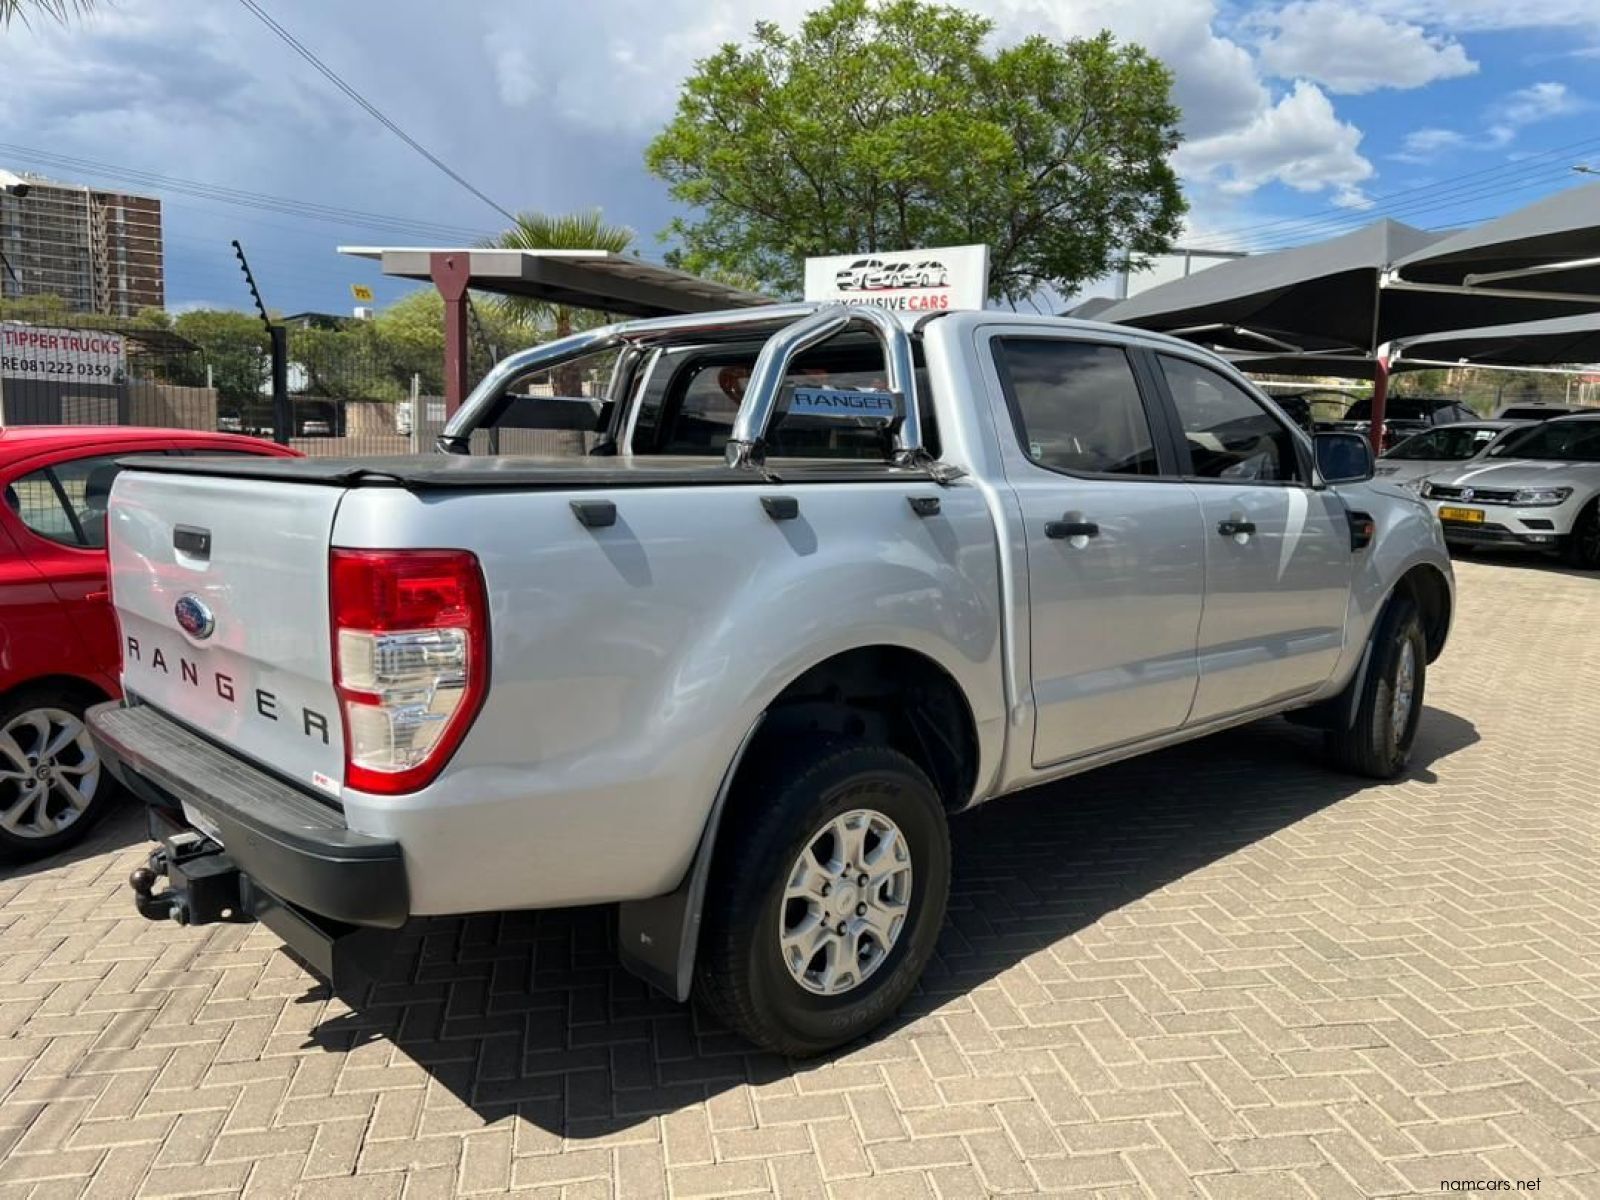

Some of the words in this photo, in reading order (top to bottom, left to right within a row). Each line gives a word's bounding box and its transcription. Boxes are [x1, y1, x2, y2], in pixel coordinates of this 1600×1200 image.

[835, 296, 906, 310] XUSIVE
[908, 295, 948, 311] CARS
[2, 331, 59, 349] TIPPER
[59, 336, 121, 355] TRUCKS
[77, 363, 112, 377] 0359
[794, 393, 893, 409] RANGER
[127, 636, 330, 745] RANGER
